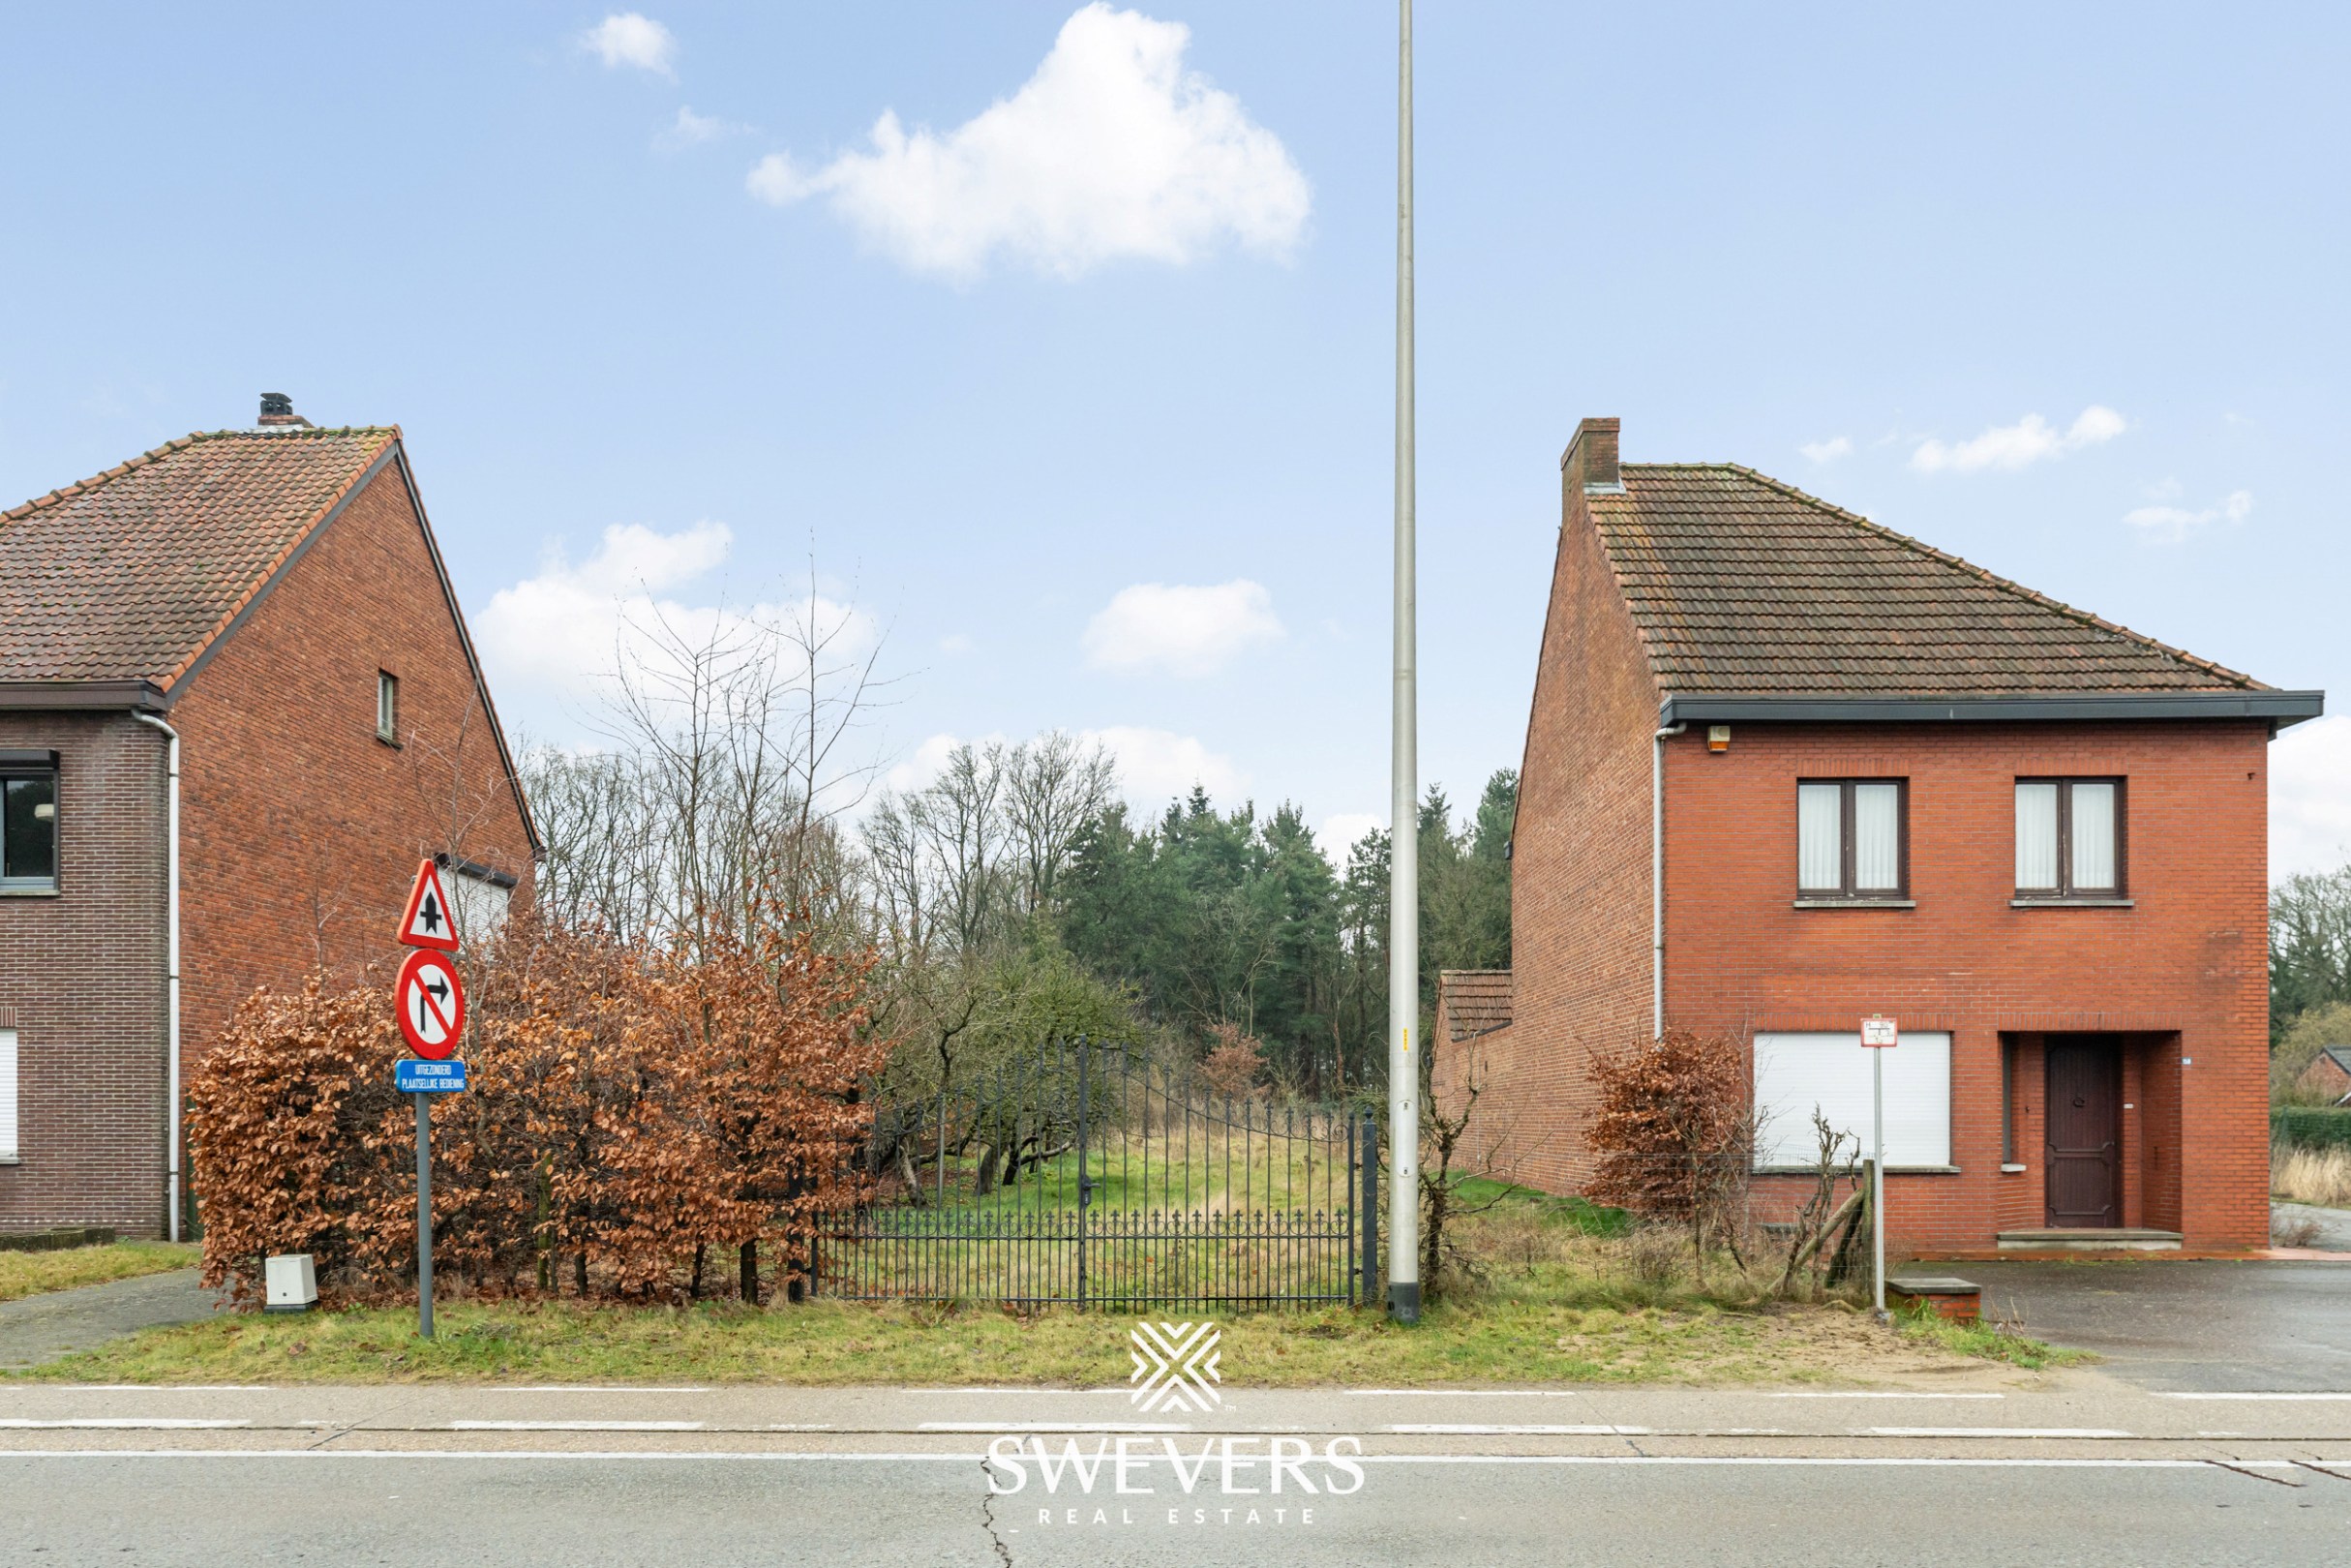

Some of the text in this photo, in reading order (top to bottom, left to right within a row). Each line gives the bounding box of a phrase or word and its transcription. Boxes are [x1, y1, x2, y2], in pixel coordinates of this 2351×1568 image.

[414, 1064, 452, 1075] UITGEZONDERD
[402, 1077, 465, 1089] PLAATSELIJKE BEDIENING
